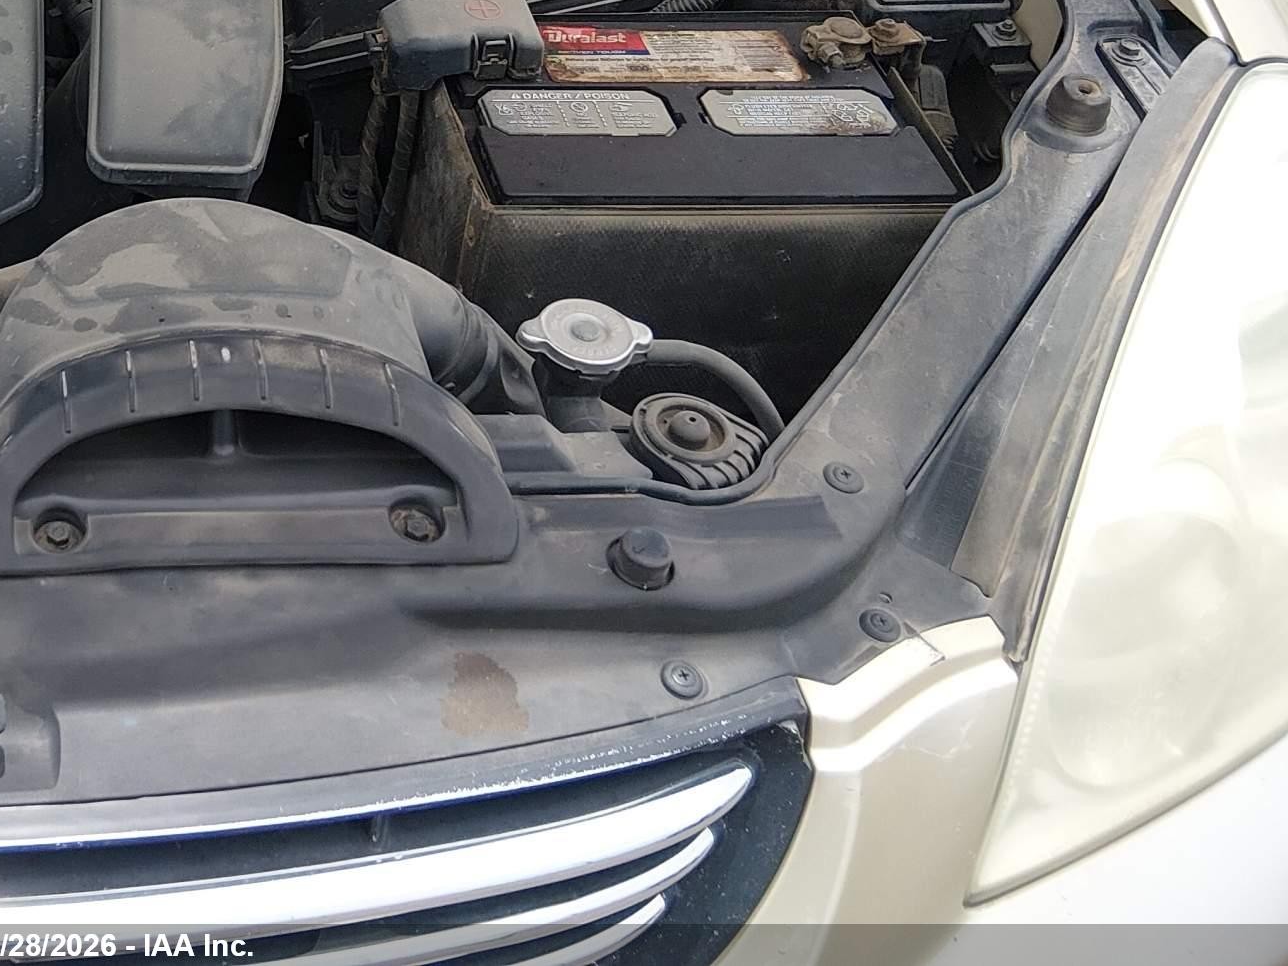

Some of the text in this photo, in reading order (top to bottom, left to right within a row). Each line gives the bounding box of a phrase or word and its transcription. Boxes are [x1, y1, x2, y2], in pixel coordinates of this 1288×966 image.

[542, 29, 627, 44] Duralast
[522, 92, 572, 100] DANGER
[583, 92, 631, 100] POISON
